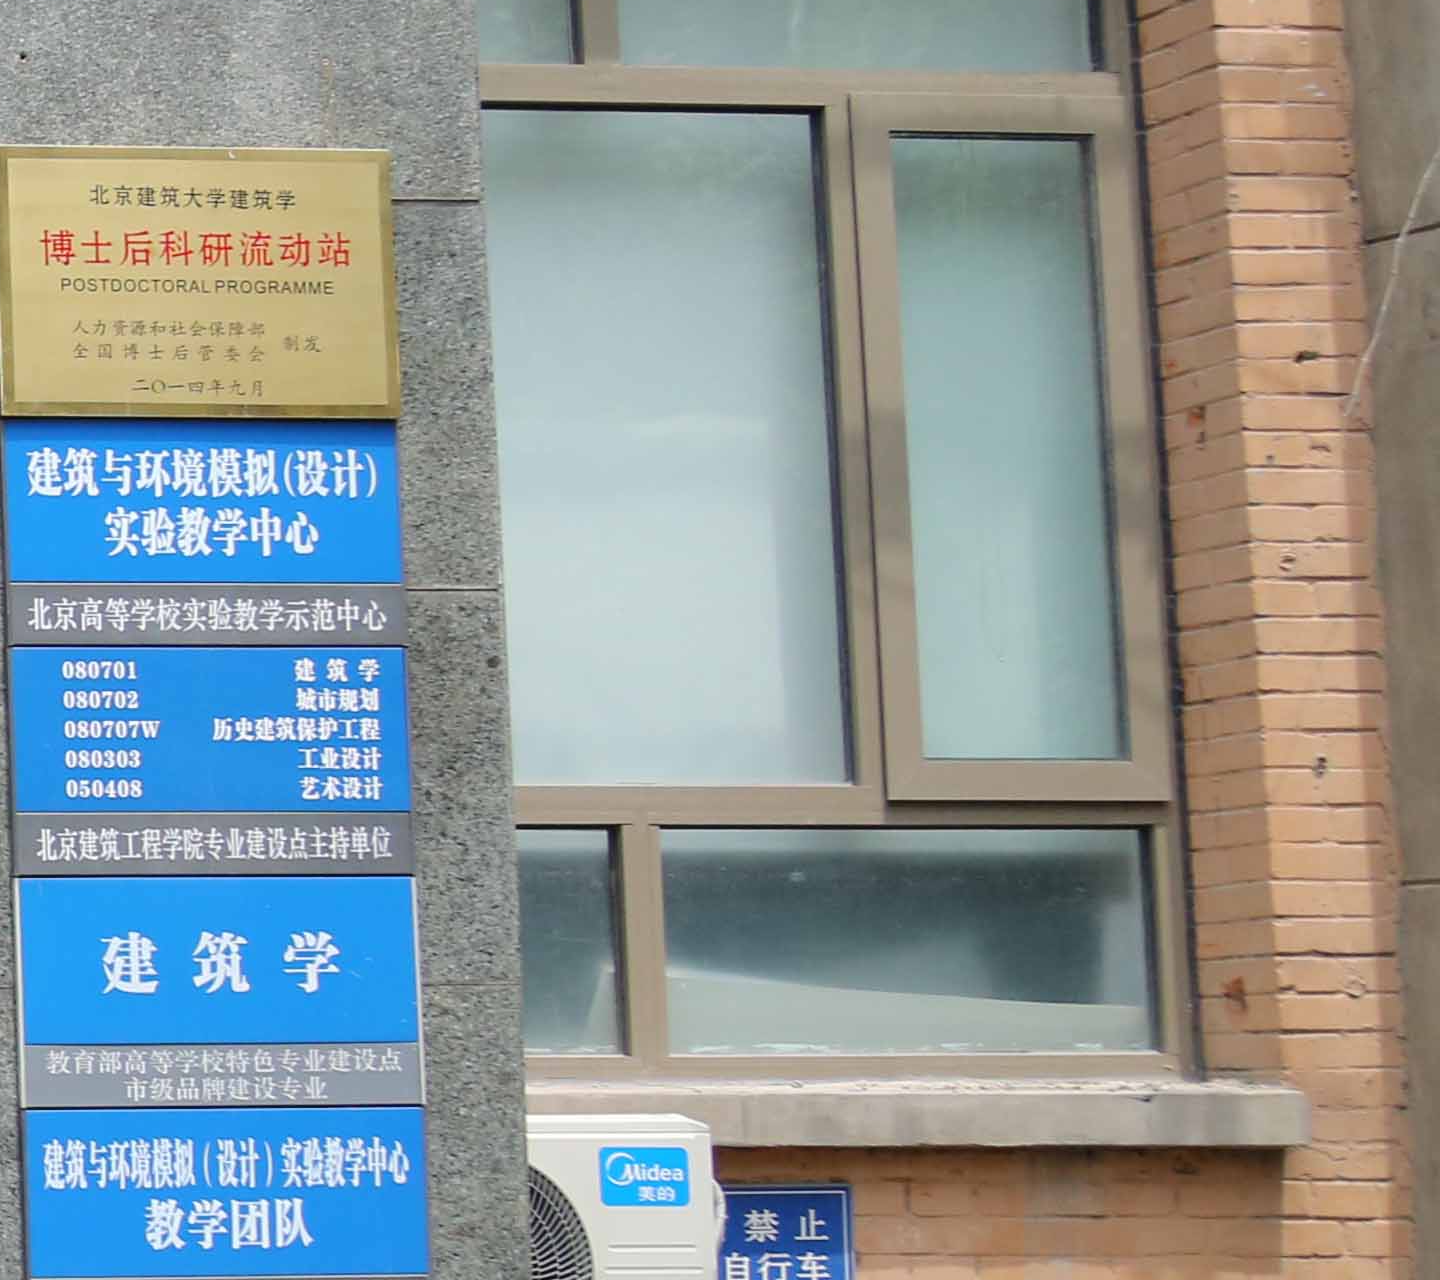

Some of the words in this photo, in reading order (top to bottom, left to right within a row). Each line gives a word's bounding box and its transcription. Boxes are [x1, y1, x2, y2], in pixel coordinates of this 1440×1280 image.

[89, 184, 297, 211] 北京建筑大学建筑学
[39, 229, 352, 267] 博士后科研流动站
[60, 277, 210, 295] POSTDOCTORAL
[215, 279, 335, 296] PROGRAMME
[73, 320, 265, 338] 人力资源和社会保障部
[73, 343, 265, 363] 全国博士后管委会
[26, 447, 379, 498] 建筑与环境模拟(设计)
[104, 506, 320, 557] 实验教学中心
[27, 596, 388, 633] 北京高等学校实验教学示范中心
[61, 660, 138, 680] 080701
[293, 657, 380, 683] 建筑学
[62, 690, 140, 709] 080702
[294, 687, 381, 712] 城市规划
[63, 719, 161, 739] 080707W
[211, 718, 382, 743] 历史建筑保护工程
[64, 749, 142, 769] 080303
[296, 746, 383, 771] 工业设计
[65, 778, 143, 799] 050408
[299, 776, 384, 801] 艺术设计
[35, 826, 393, 862] 北京建筑工程学院专业建设点主持单位
[99, 930, 342, 995] 建筑学
[46, 1047, 403, 1075] 教育部高等学校特色专业建设点
[123, 1076, 329, 1102] 市级品牌建设专业
[42, 1136, 411, 1190] 建筑与环境模拟（设计）实验教学中心
[612, 1156, 685, 1184] Midea
[637, 1185, 676, 1202] 美的
[144, 1197, 316, 1251] 教学团队
